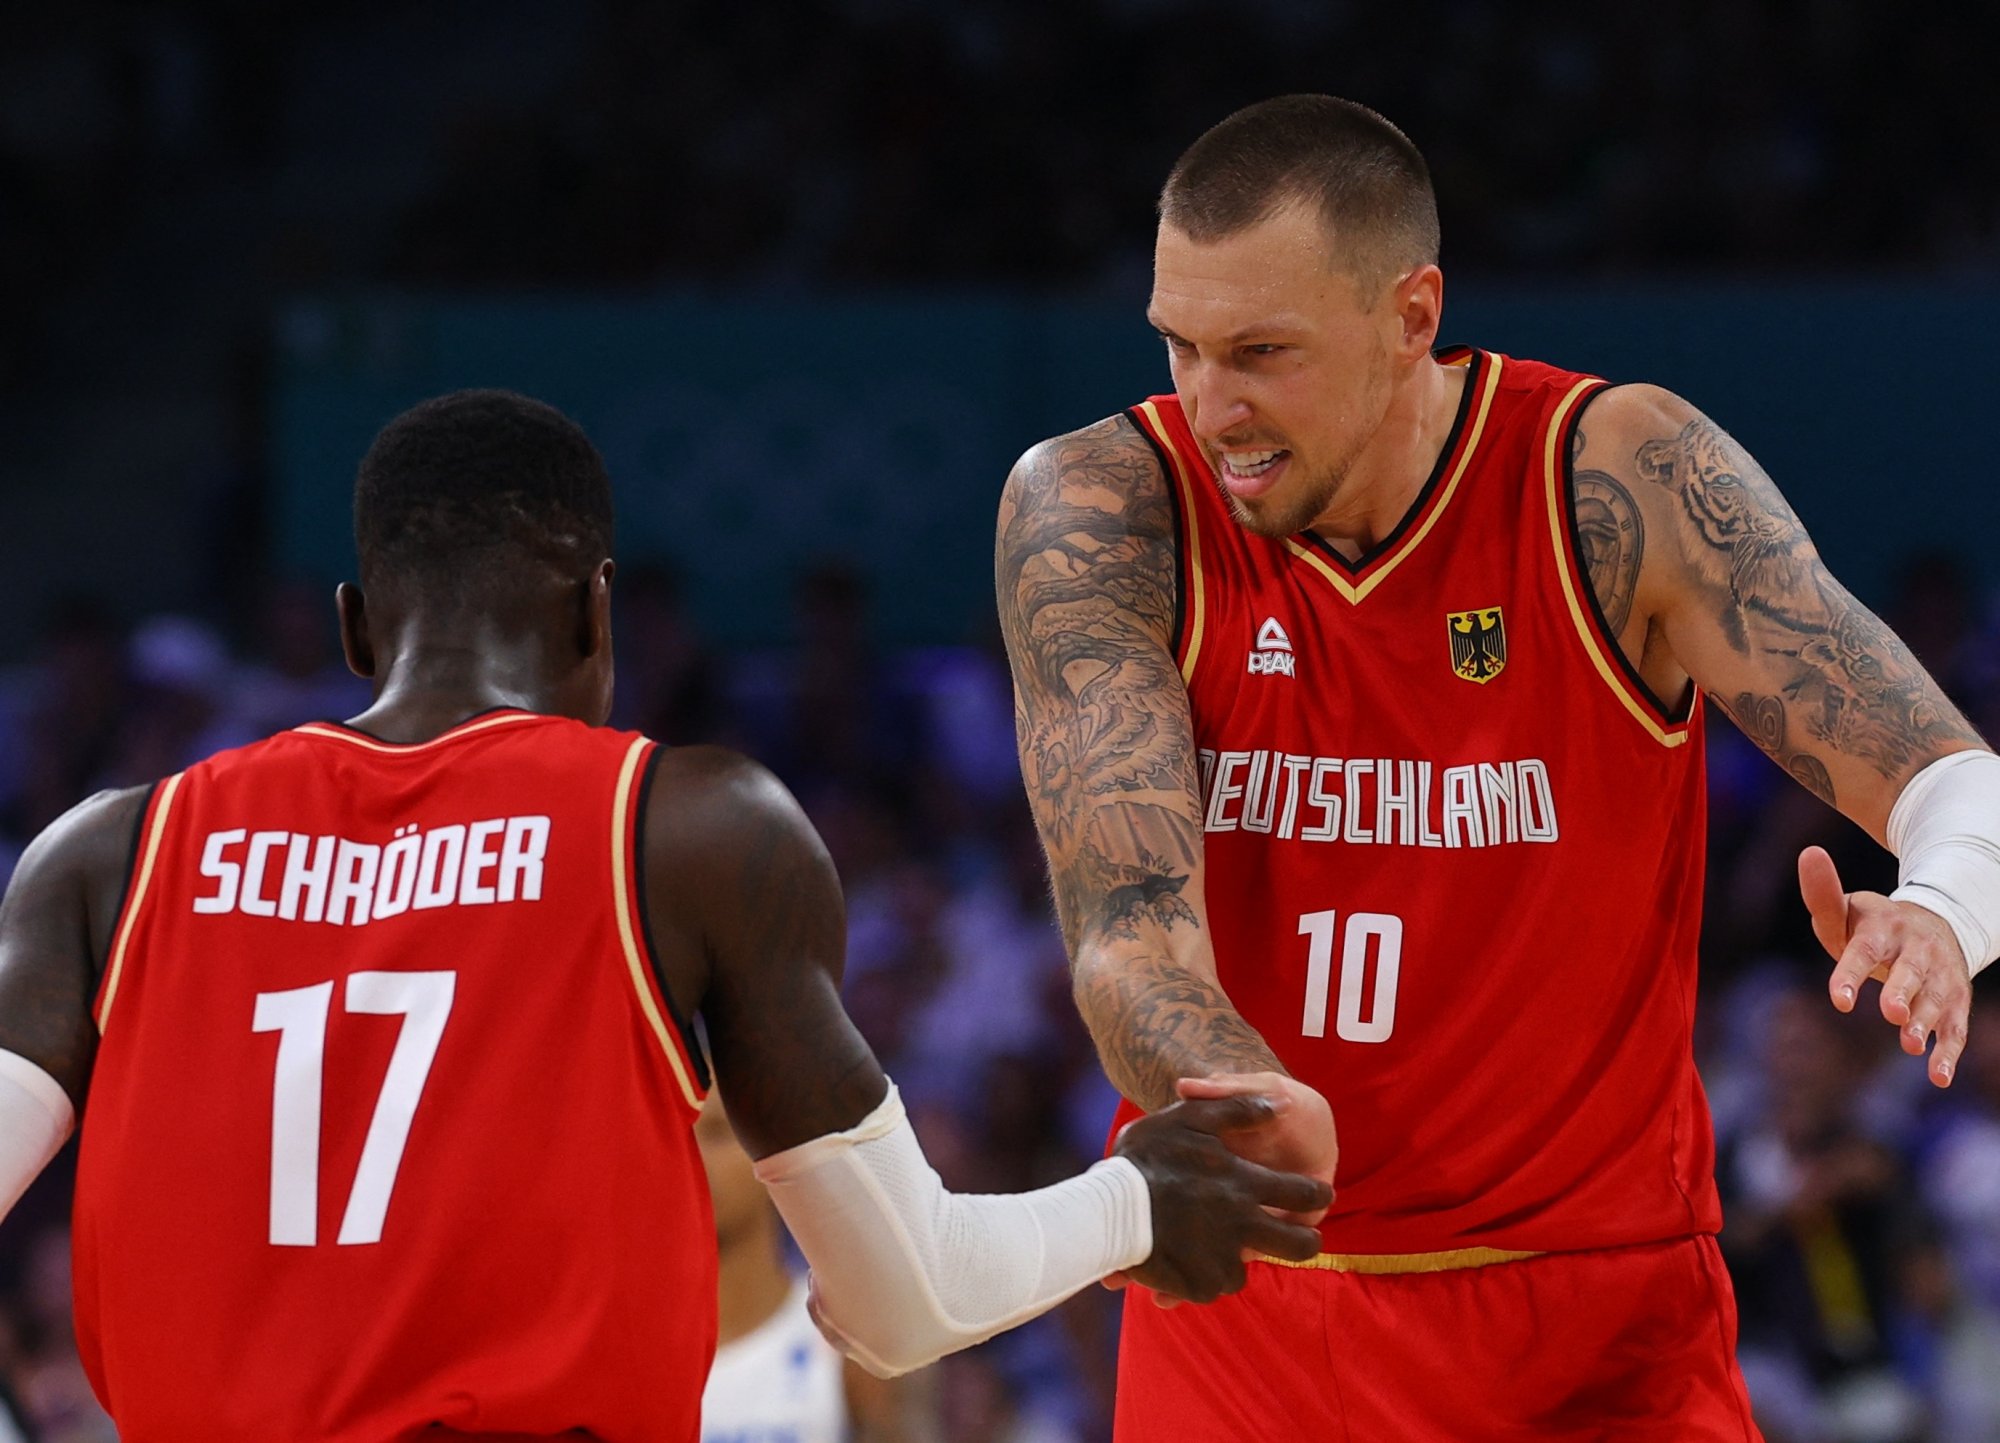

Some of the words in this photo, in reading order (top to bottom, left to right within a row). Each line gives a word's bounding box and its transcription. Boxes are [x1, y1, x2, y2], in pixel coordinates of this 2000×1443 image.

[1247, 650, 1296, 680] PEAK
[192, 815, 552, 927] SCHRÖDER
[1297, 909, 1404, 1044] 10
[251, 969, 457, 1247] 17
